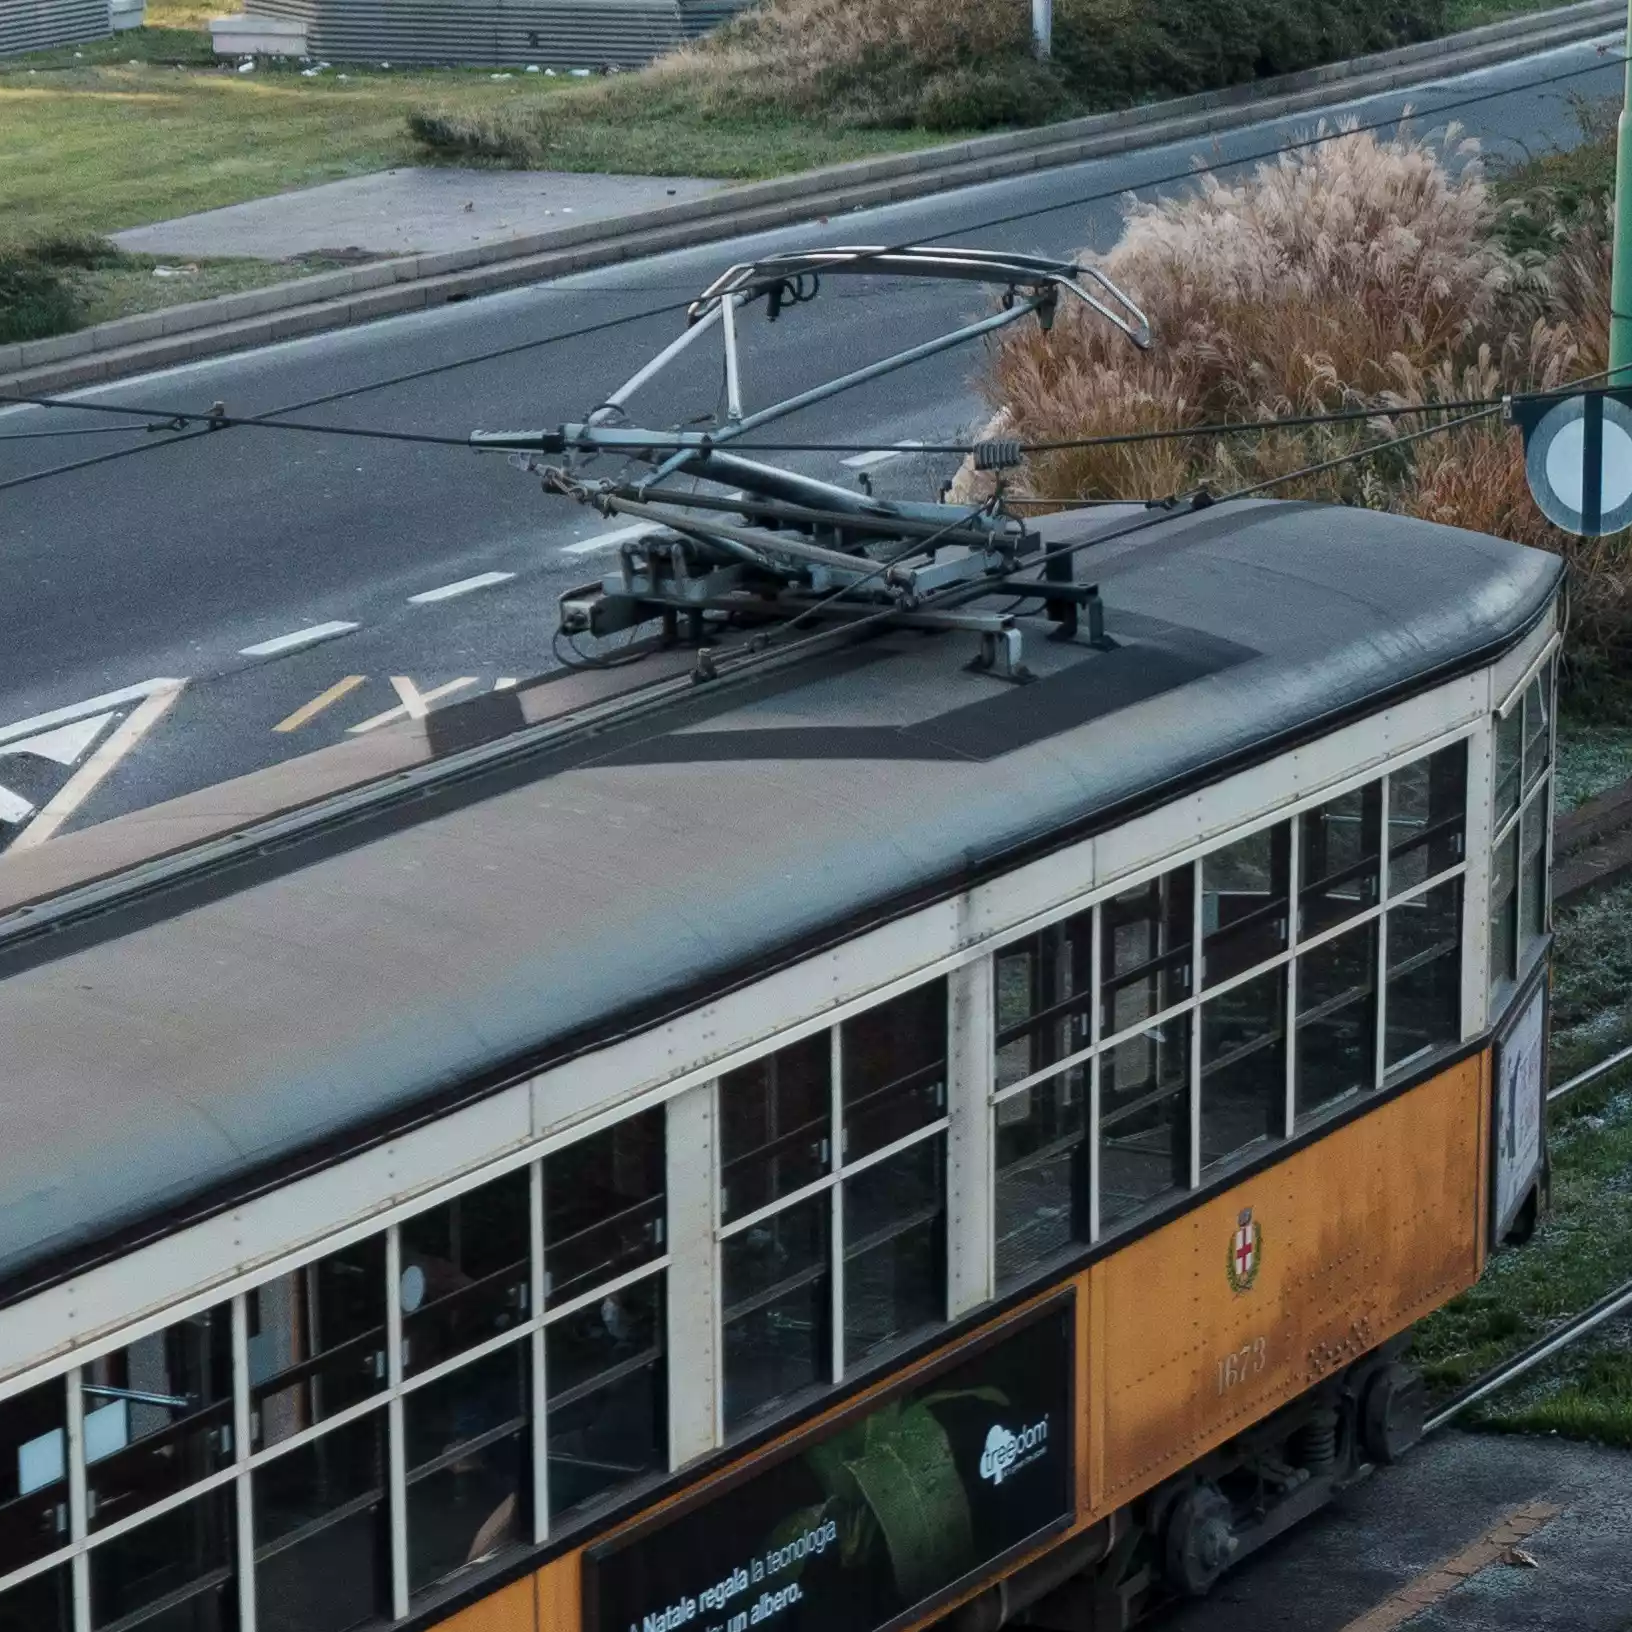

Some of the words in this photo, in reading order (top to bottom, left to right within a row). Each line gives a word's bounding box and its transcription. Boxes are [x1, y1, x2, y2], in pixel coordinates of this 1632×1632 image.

[1217, 1336, 1266, 1396] 1673
[980, 1421, 1048, 1479] treedom
[699, 1567, 748, 1613] regala
[750, 1557, 765, 1583] la
[766, 1517, 837, 1574] tecnologia
[750, 1583, 804, 1625] albero.
